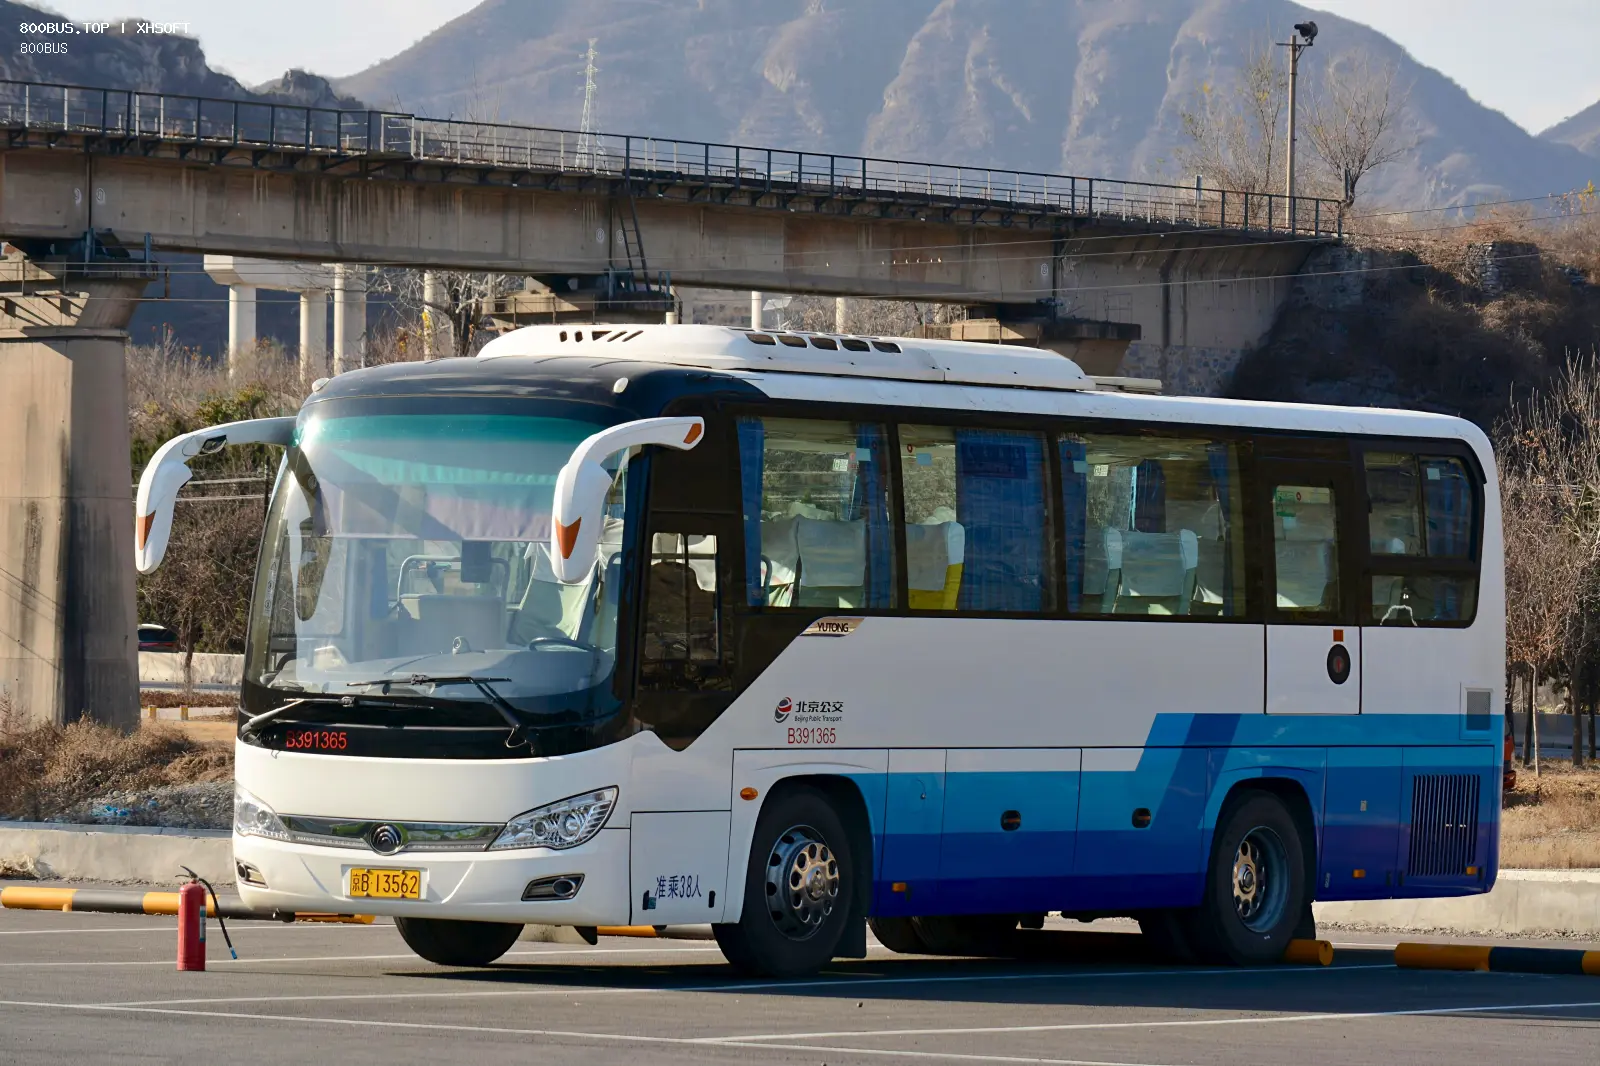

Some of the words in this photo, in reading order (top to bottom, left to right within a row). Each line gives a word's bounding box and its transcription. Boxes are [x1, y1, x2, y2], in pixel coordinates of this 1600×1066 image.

[817, 622, 849, 633] YUTONG
[795, 700, 844, 713] 北京公交
[794, 715, 809, 723] Beijing
[286, 730, 348, 749] B391365
[787, 727, 837, 744] B391365
[655, 874, 702, 899] 准乘38人
